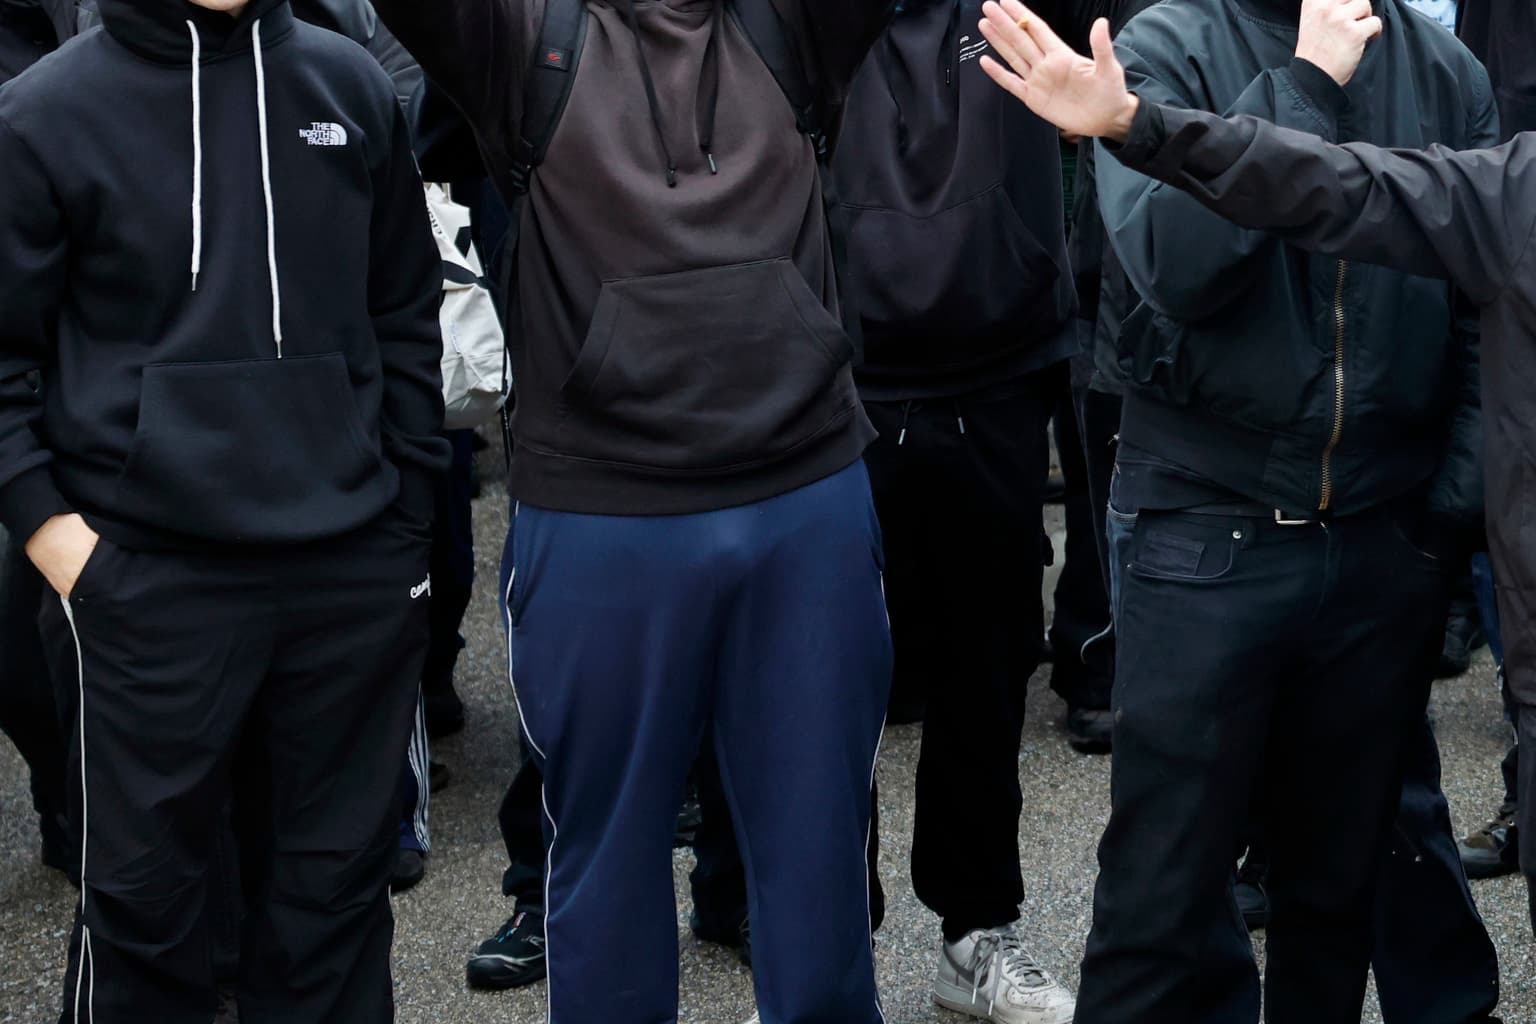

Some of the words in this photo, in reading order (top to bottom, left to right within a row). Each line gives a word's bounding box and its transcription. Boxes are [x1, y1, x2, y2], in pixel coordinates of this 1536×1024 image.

[310, 122, 331, 130] THE
[299, 129, 330, 138] NORTH
[307, 137, 331, 145] FACE
